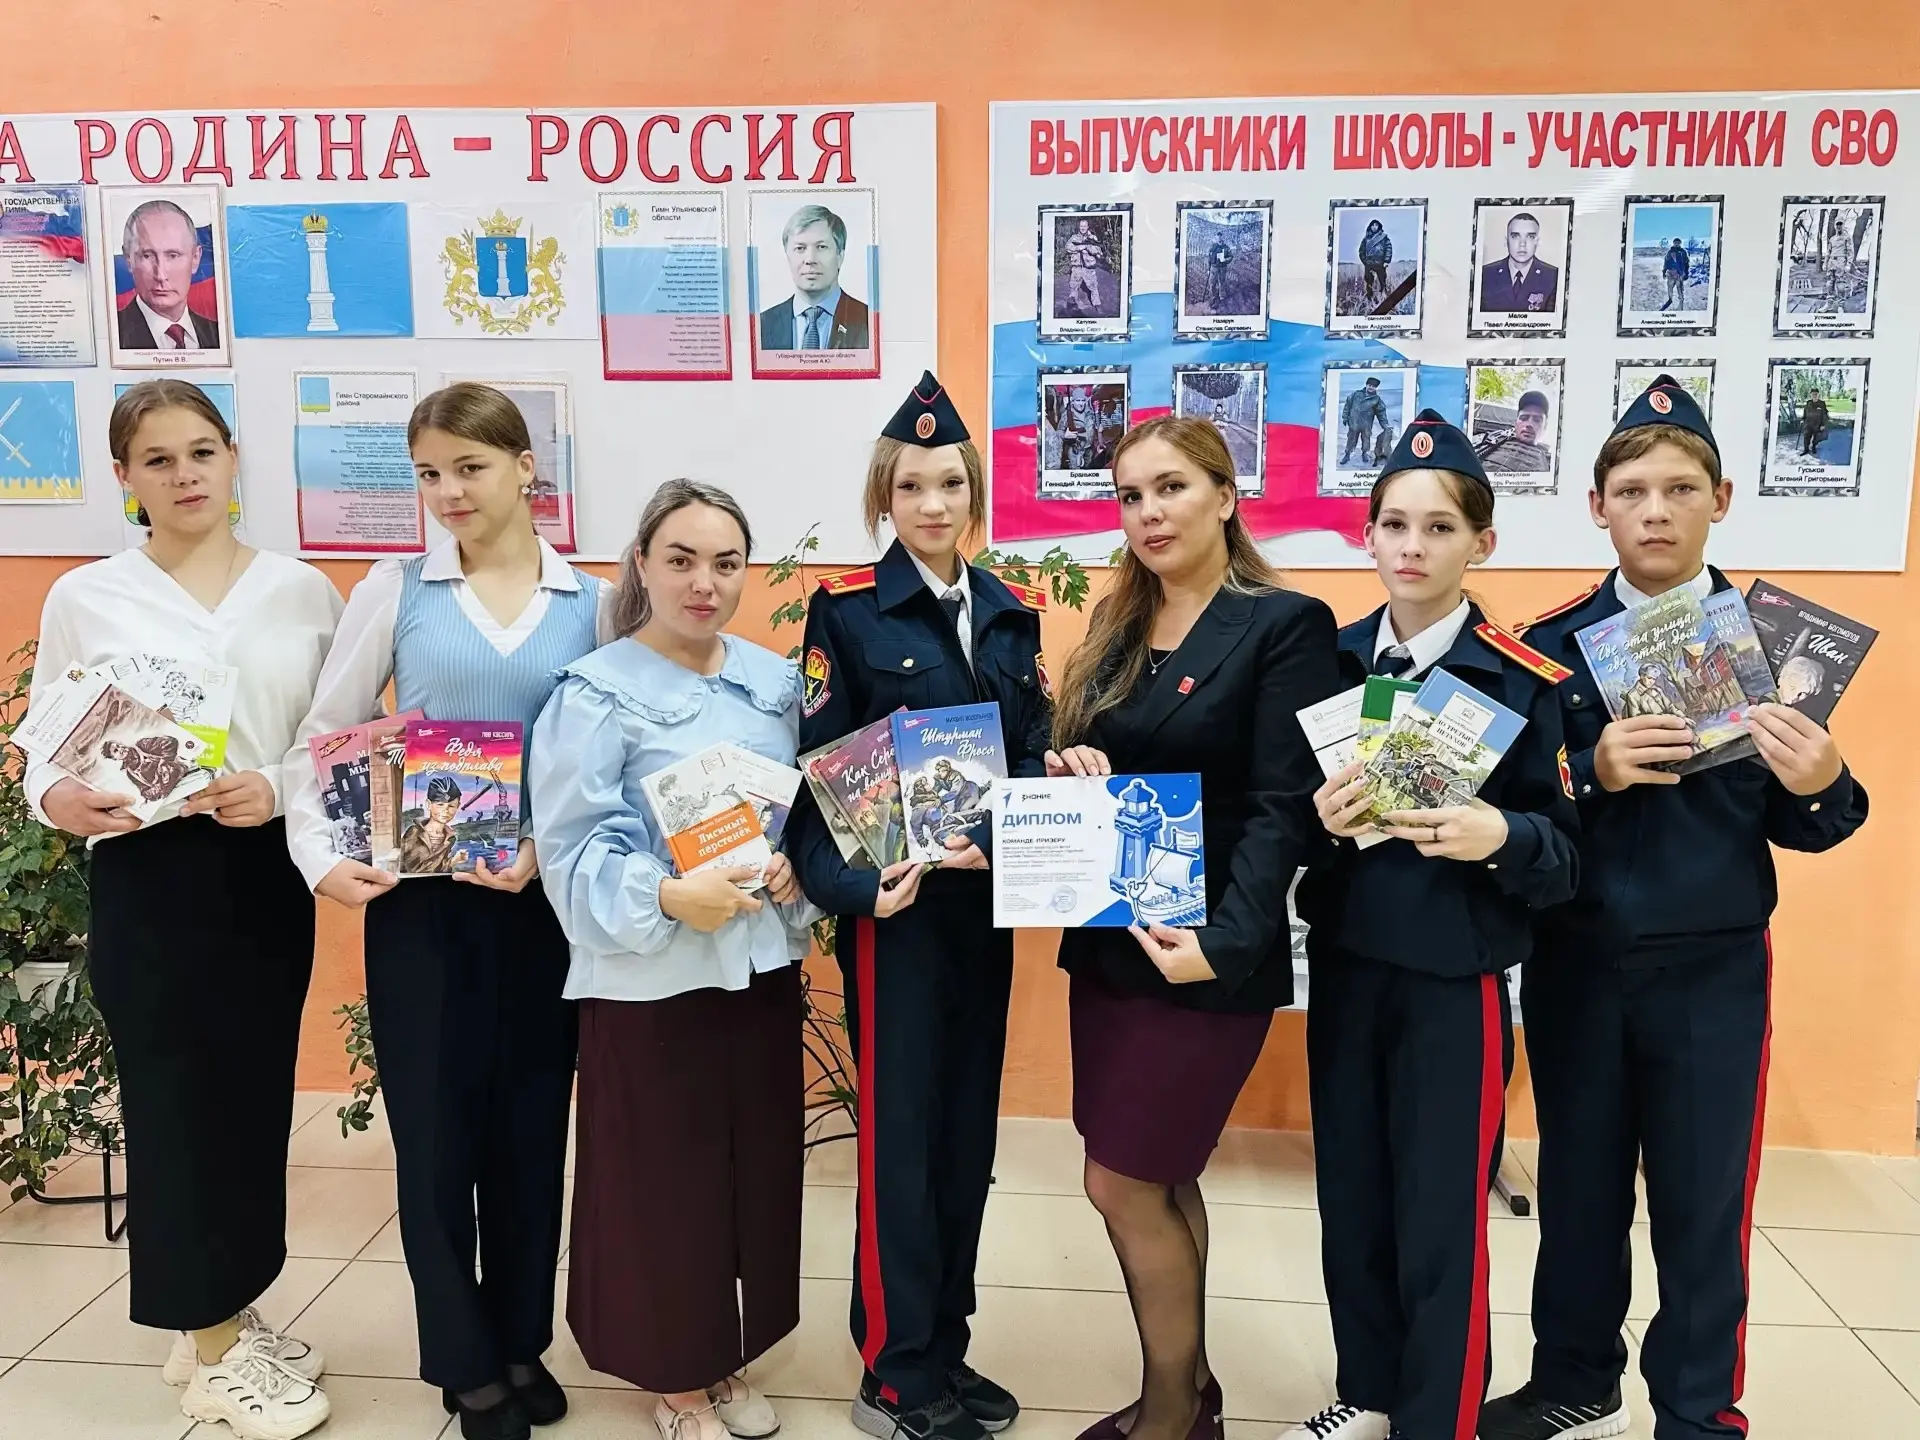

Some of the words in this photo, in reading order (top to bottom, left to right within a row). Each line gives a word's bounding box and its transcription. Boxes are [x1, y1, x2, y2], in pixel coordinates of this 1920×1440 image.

[75, 114, 430, 187] РОДИНА
[526, 112, 856, 183] РОССИЯ
[1029, 115, 1306, 176] ВЫПУСКНИКИ
[1333, 112, 1492, 170] ШКОЛЫ
[1527, 110, 1787, 168] УЧАСТНИКИ
[1811, 108, 1898, 167] СВО
[652, 205, 669, 213] Гимн
[671, 205, 717, 213] Ульяновской
[652, 213, 681, 221] области
[1804, 475, 1847, 483] Григорьевич
[1595, 643, 1618, 662] Где
[1623, 631, 1648, 650] эта
[1651, 612, 1696, 636] улица,
[1717, 623, 1746, 639] РЯД
[1607, 655, 1627, 673] где
[1631, 641, 1667, 662] этот
[1671, 626, 1699, 645] дом
[1808, 634, 1848, 665] Иван
[444, 737, 482, 757] Федя
[920, 727, 983, 747] Штурман
[957, 739, 996, 761] Фрося
[422, 762, 438, 776] из
[440, 757, 504, 773] подплава
[841, 765, 870, 787] Как
[698, 814, 748, 844] Лисиный
[1002, 813, 1082, 828] ДИПЛОМ
[698, 826, 752, 857] перстенёк
